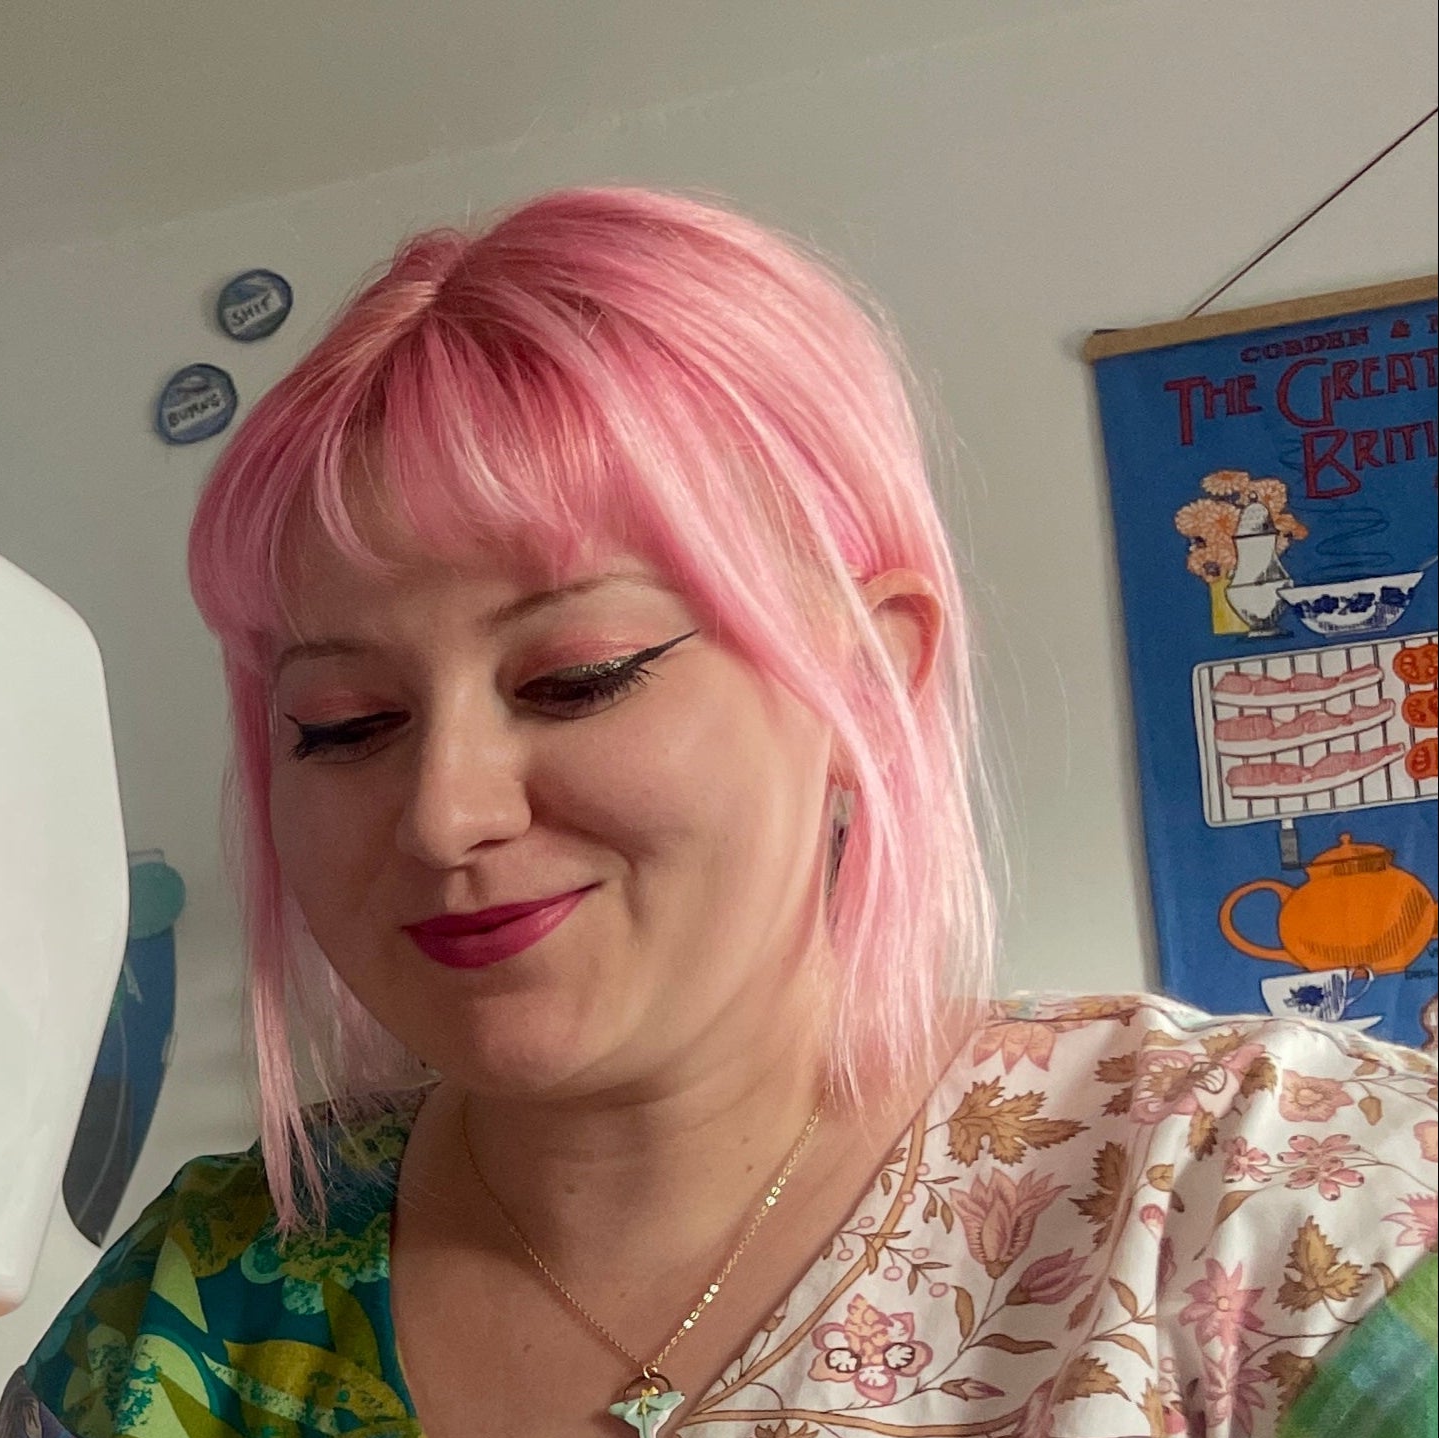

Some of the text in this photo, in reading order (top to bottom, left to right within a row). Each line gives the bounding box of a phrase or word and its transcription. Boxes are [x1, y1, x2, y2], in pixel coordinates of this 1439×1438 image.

[230, 291, 272, 327] SHIT
[1240, 327, 1369, 363] COBDEN
[1390, 319, 1411, 338] &
[1164, 347, 1439, 446] THE GREAT
